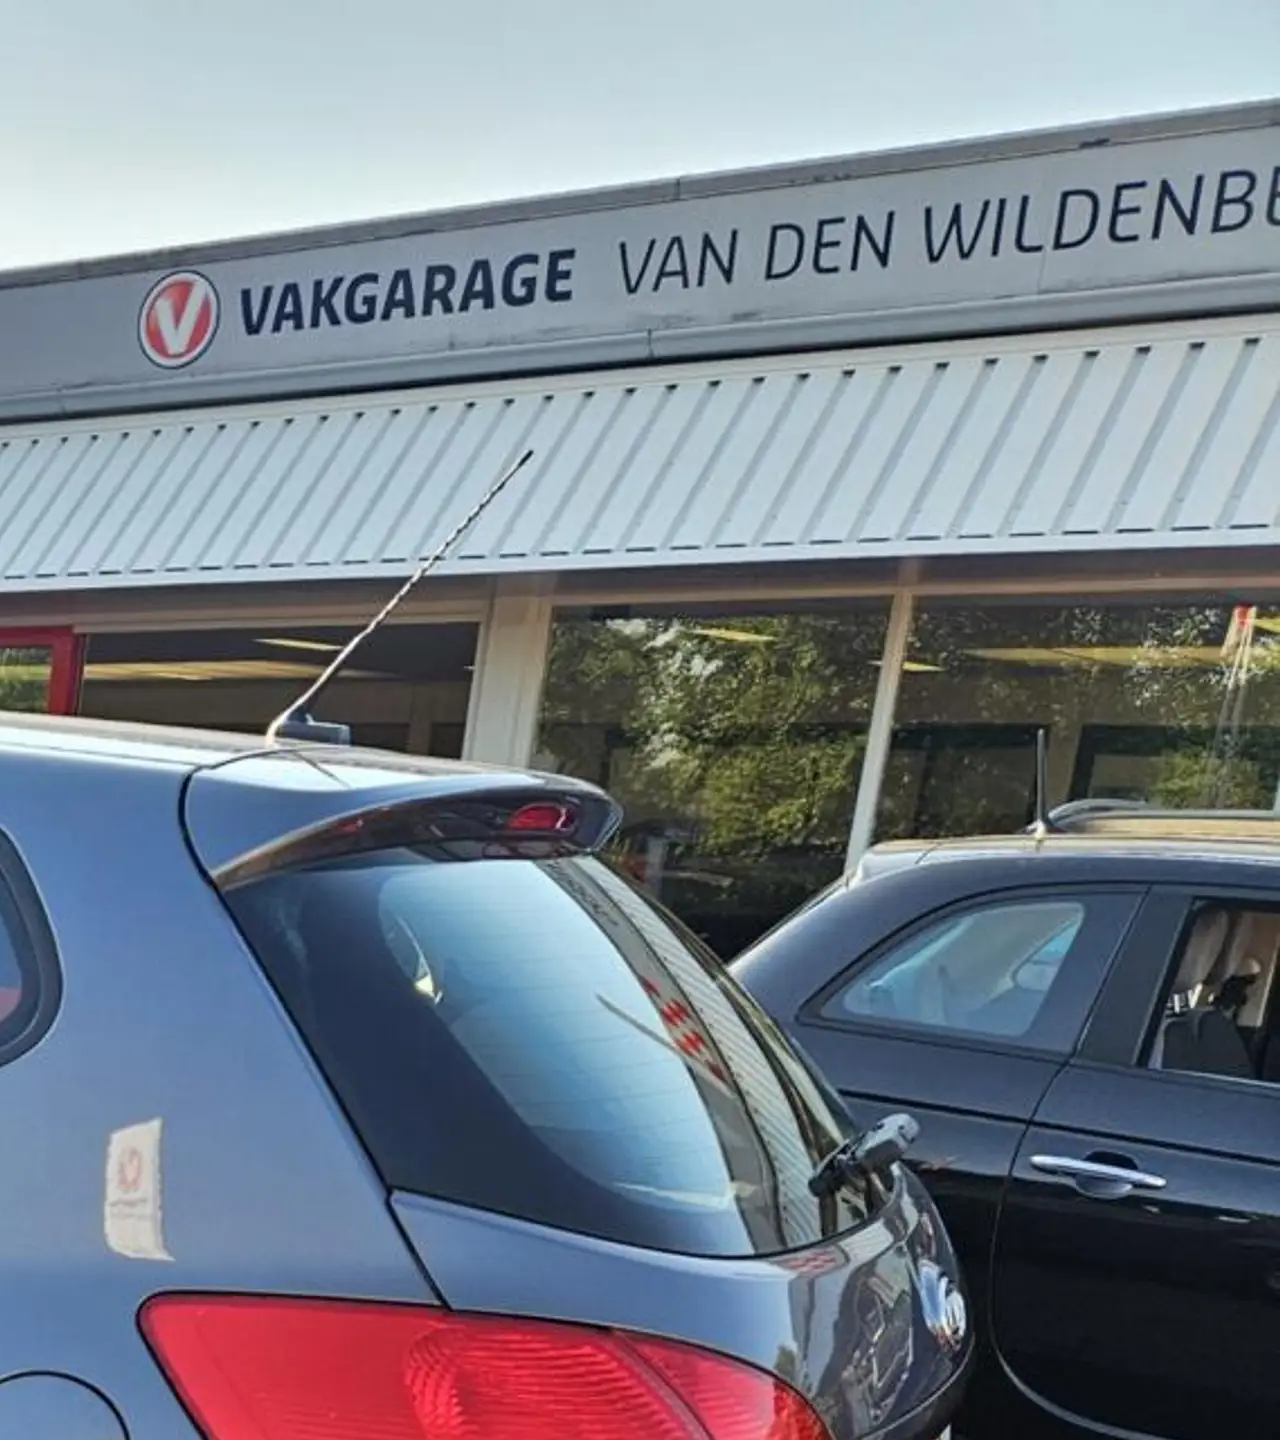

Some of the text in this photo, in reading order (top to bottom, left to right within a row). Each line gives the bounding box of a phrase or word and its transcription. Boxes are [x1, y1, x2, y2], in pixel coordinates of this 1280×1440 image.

[241, 248, 576, 336] VAKGARAGE
[619, 228, 739, 295] VAN
[764, 209, 896, 281] DEN
